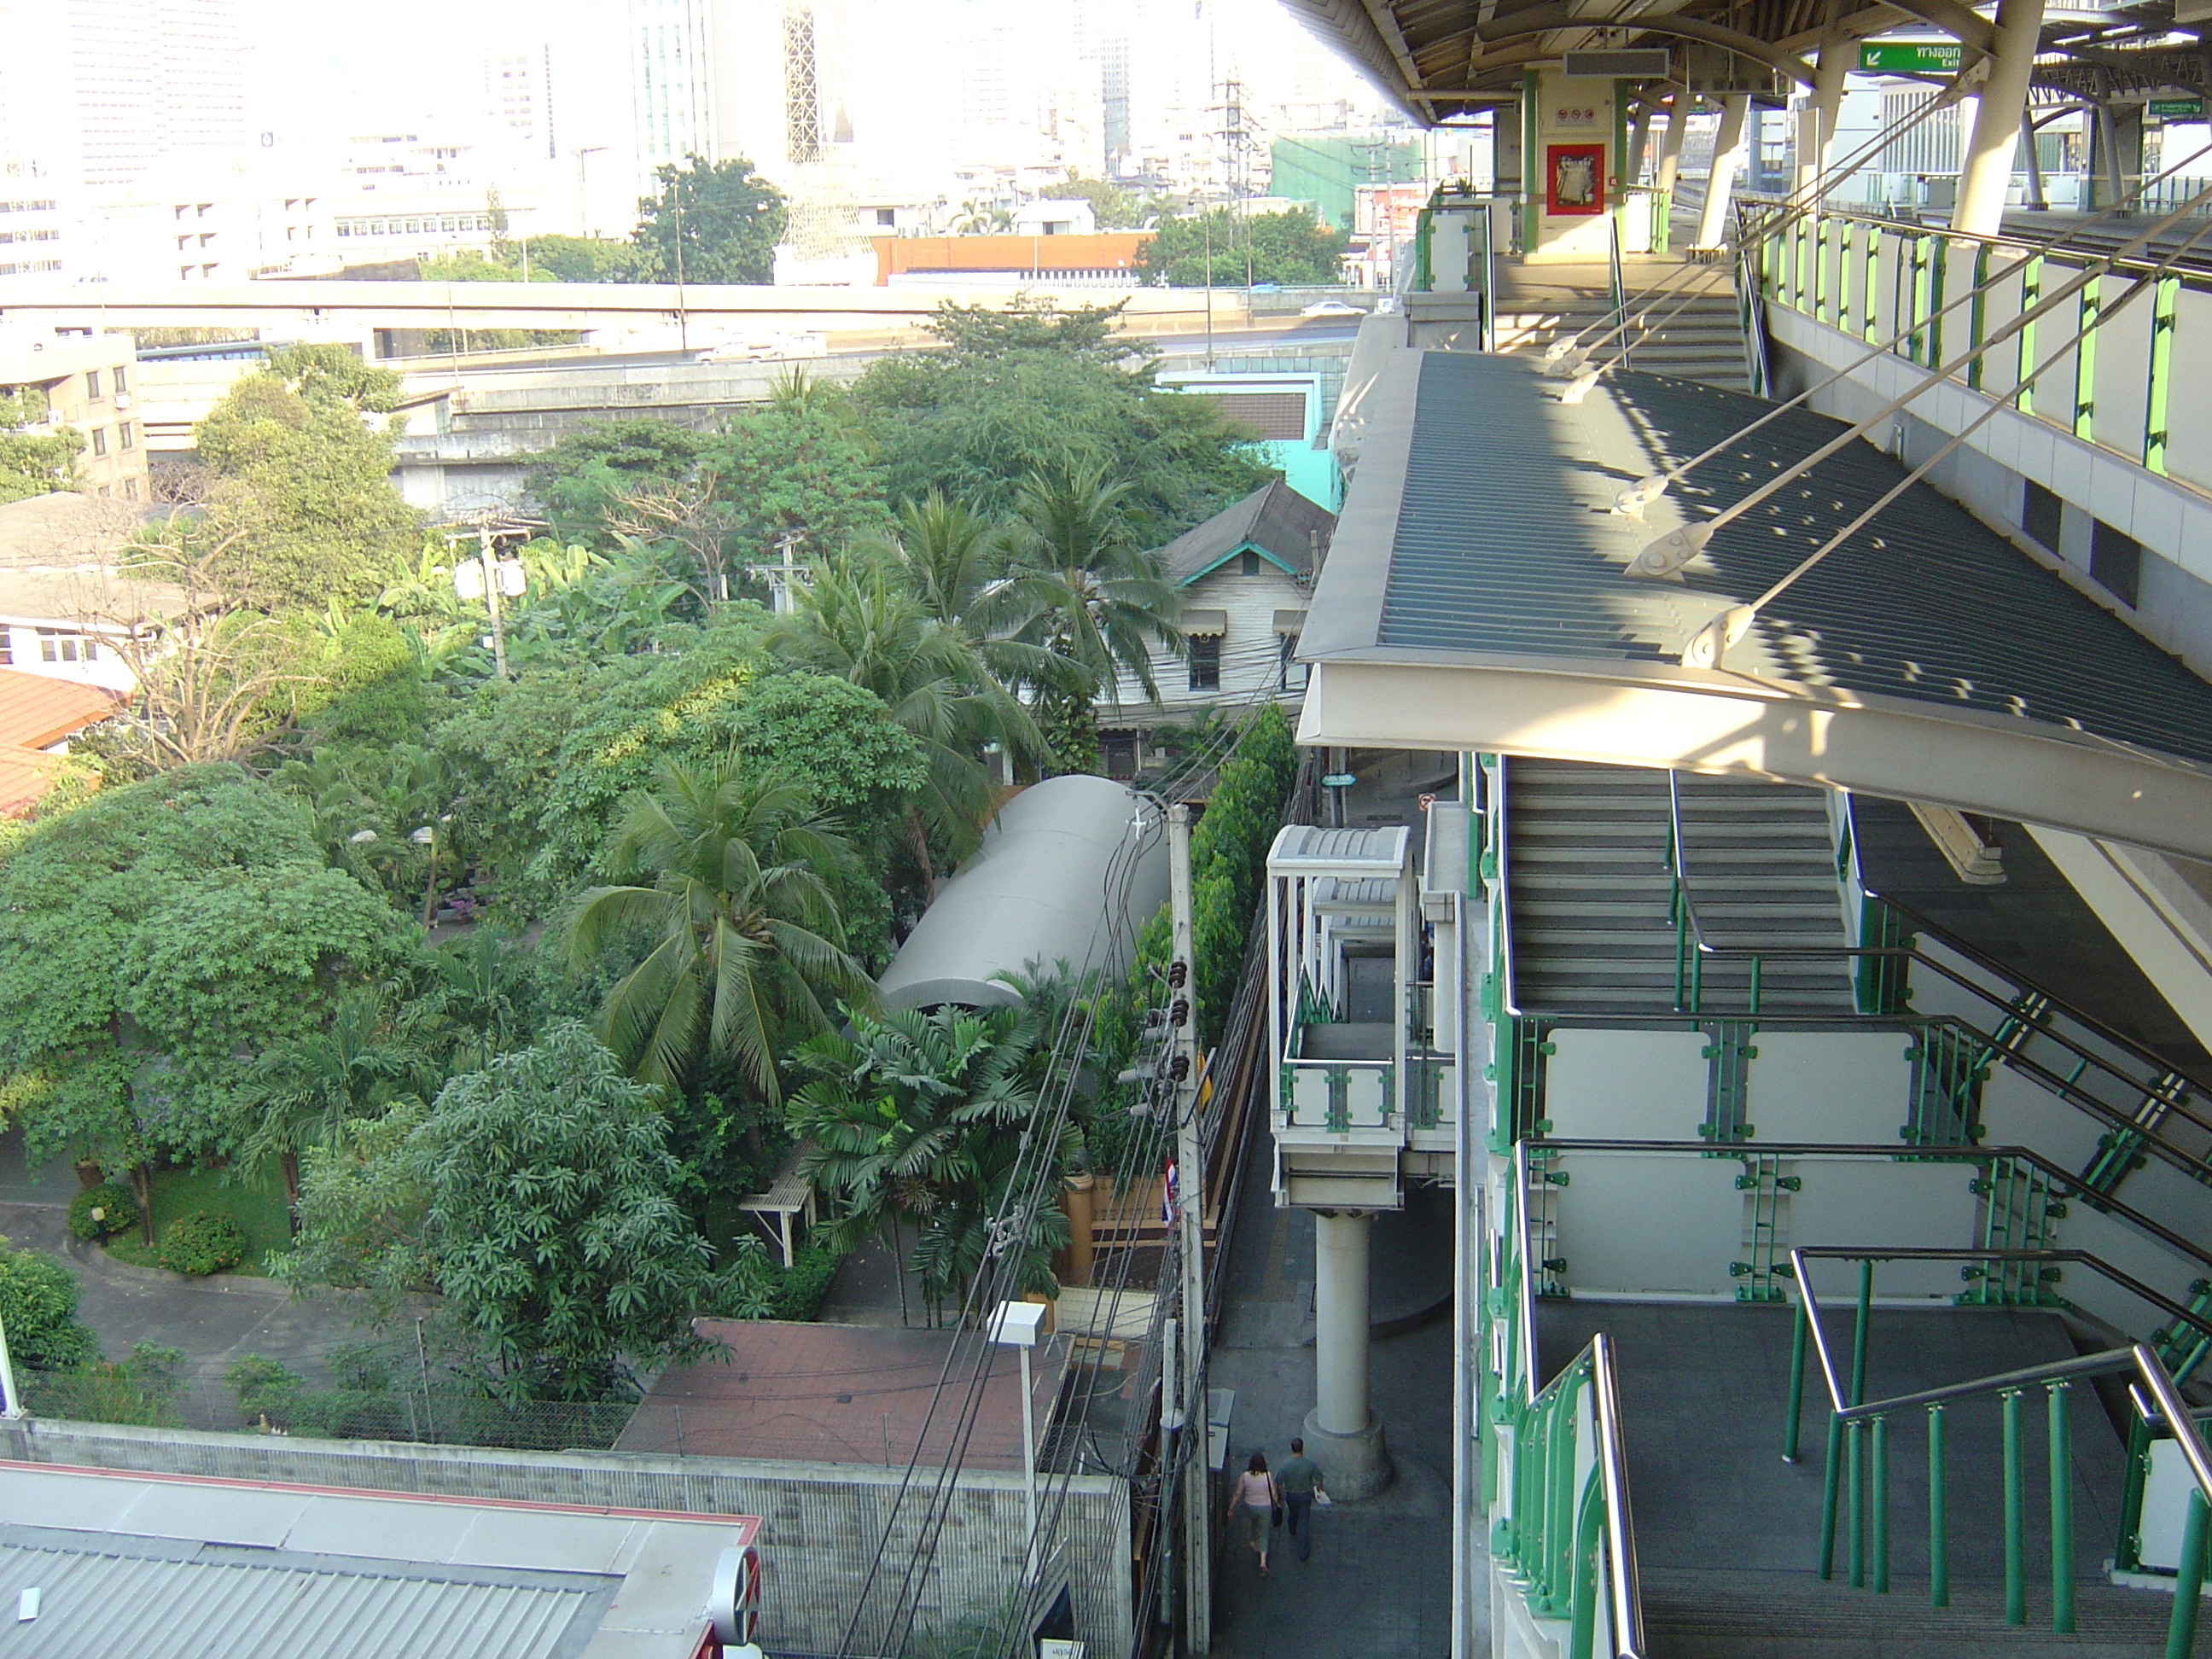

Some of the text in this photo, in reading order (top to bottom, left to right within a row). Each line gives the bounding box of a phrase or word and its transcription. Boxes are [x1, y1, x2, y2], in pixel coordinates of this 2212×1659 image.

[1917, 46, 1961, 58] ทางออก
[1941, 58, 1960, 67] Exit
